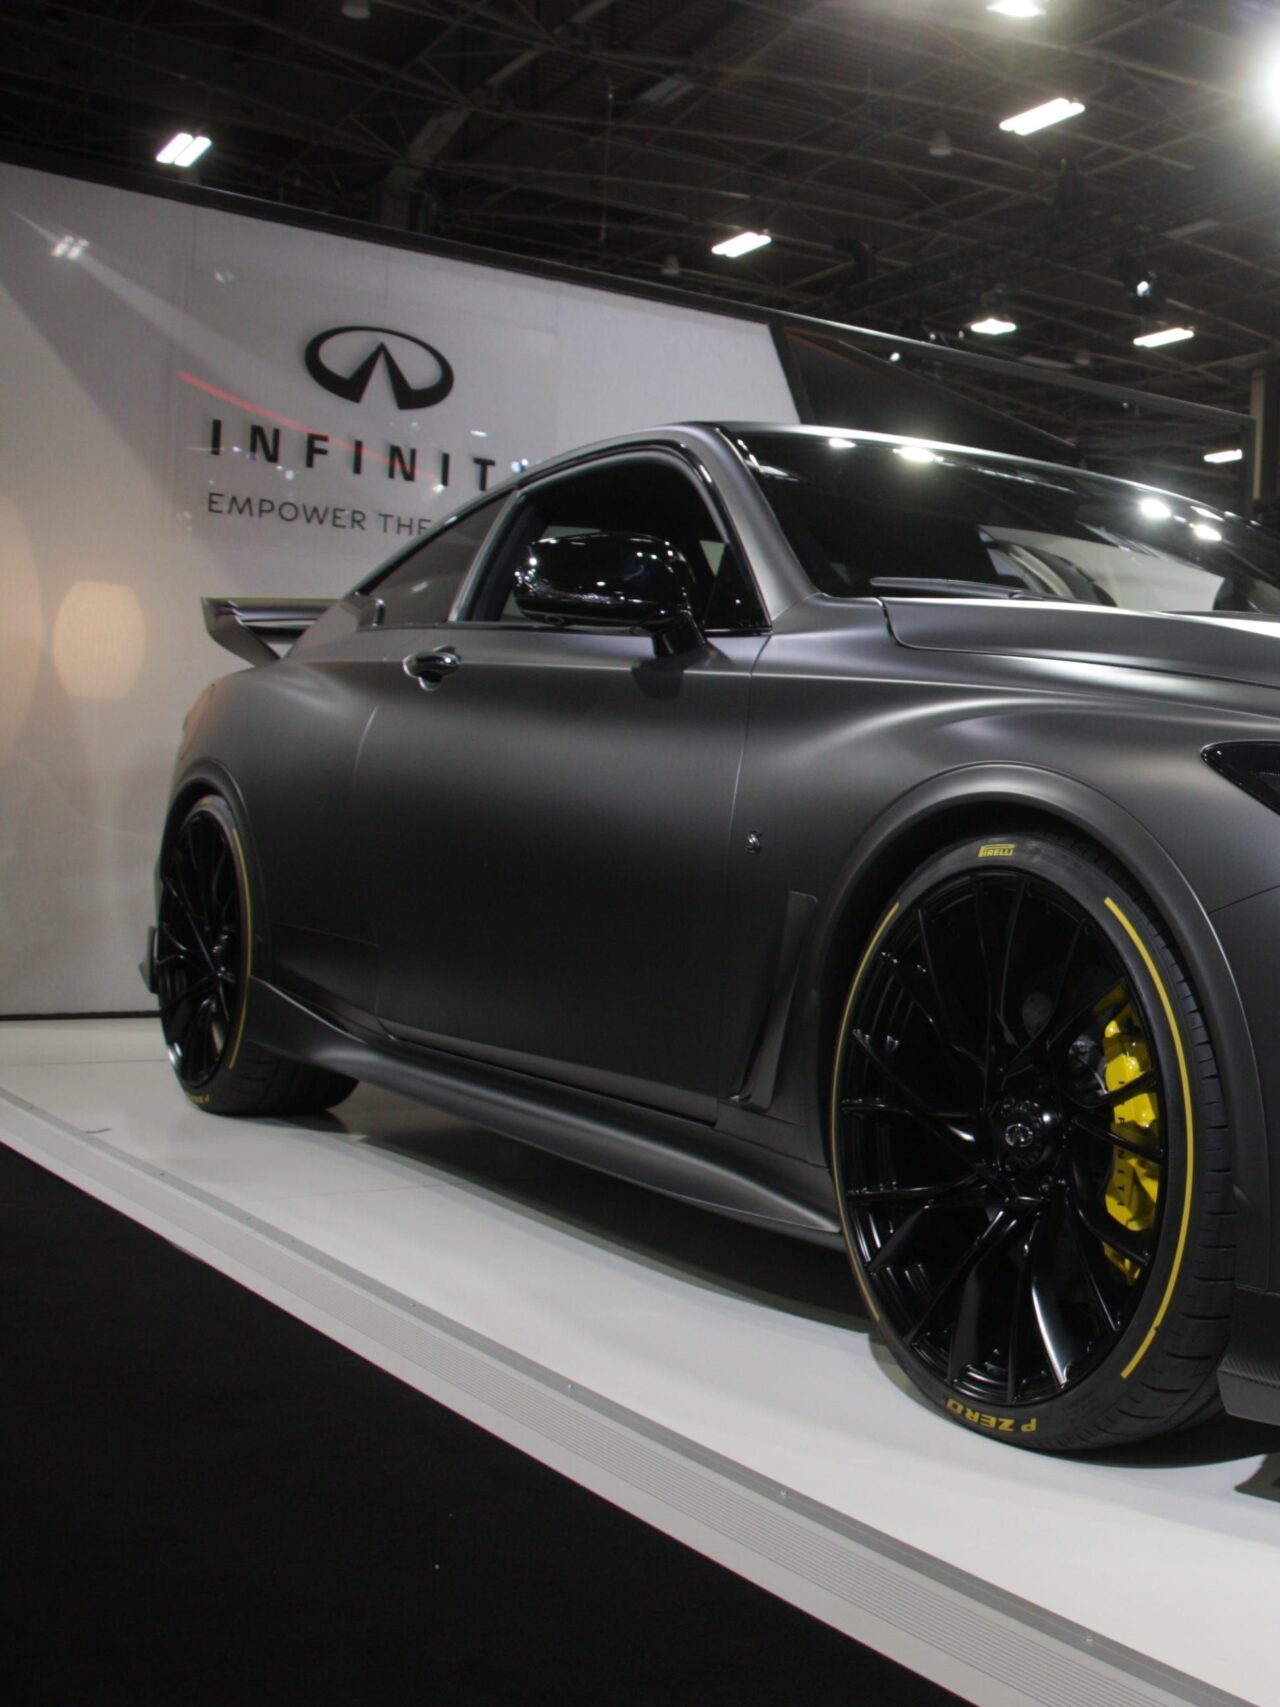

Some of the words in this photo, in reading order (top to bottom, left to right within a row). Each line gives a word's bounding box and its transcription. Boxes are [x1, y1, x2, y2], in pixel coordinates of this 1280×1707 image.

[210, 419, 524, 491] INFINIT
[207, 492, 367, 531] EMPOWER
[978, 843, 1015, 858] PIRELLI
[946, 1399, 1015, 1432] ZERO
[1021, 1418, 1037, 1433] P
